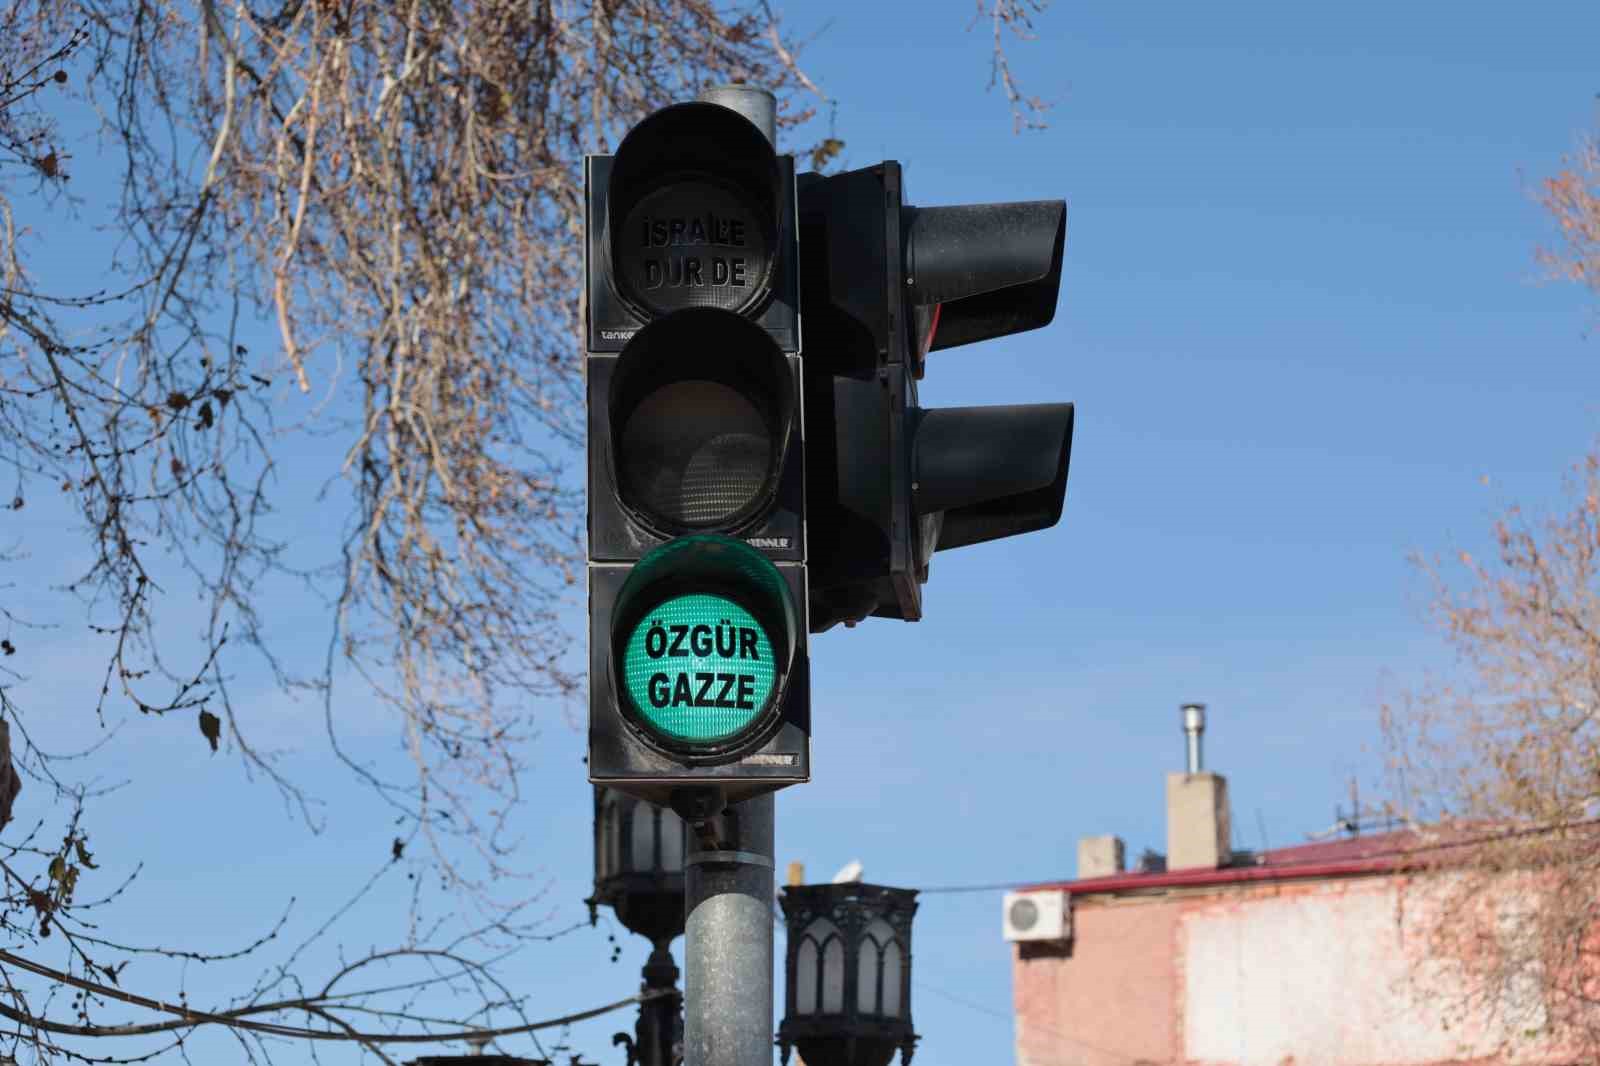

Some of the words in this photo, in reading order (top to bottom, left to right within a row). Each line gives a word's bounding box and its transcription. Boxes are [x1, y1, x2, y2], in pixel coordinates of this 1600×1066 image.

[646, 258, 704, 288] DUR
[712, 258, 746, 287] DE
[646, 620, 760, 661] ÖZGÜR
[648, 672, 755, 710] GAZZE
